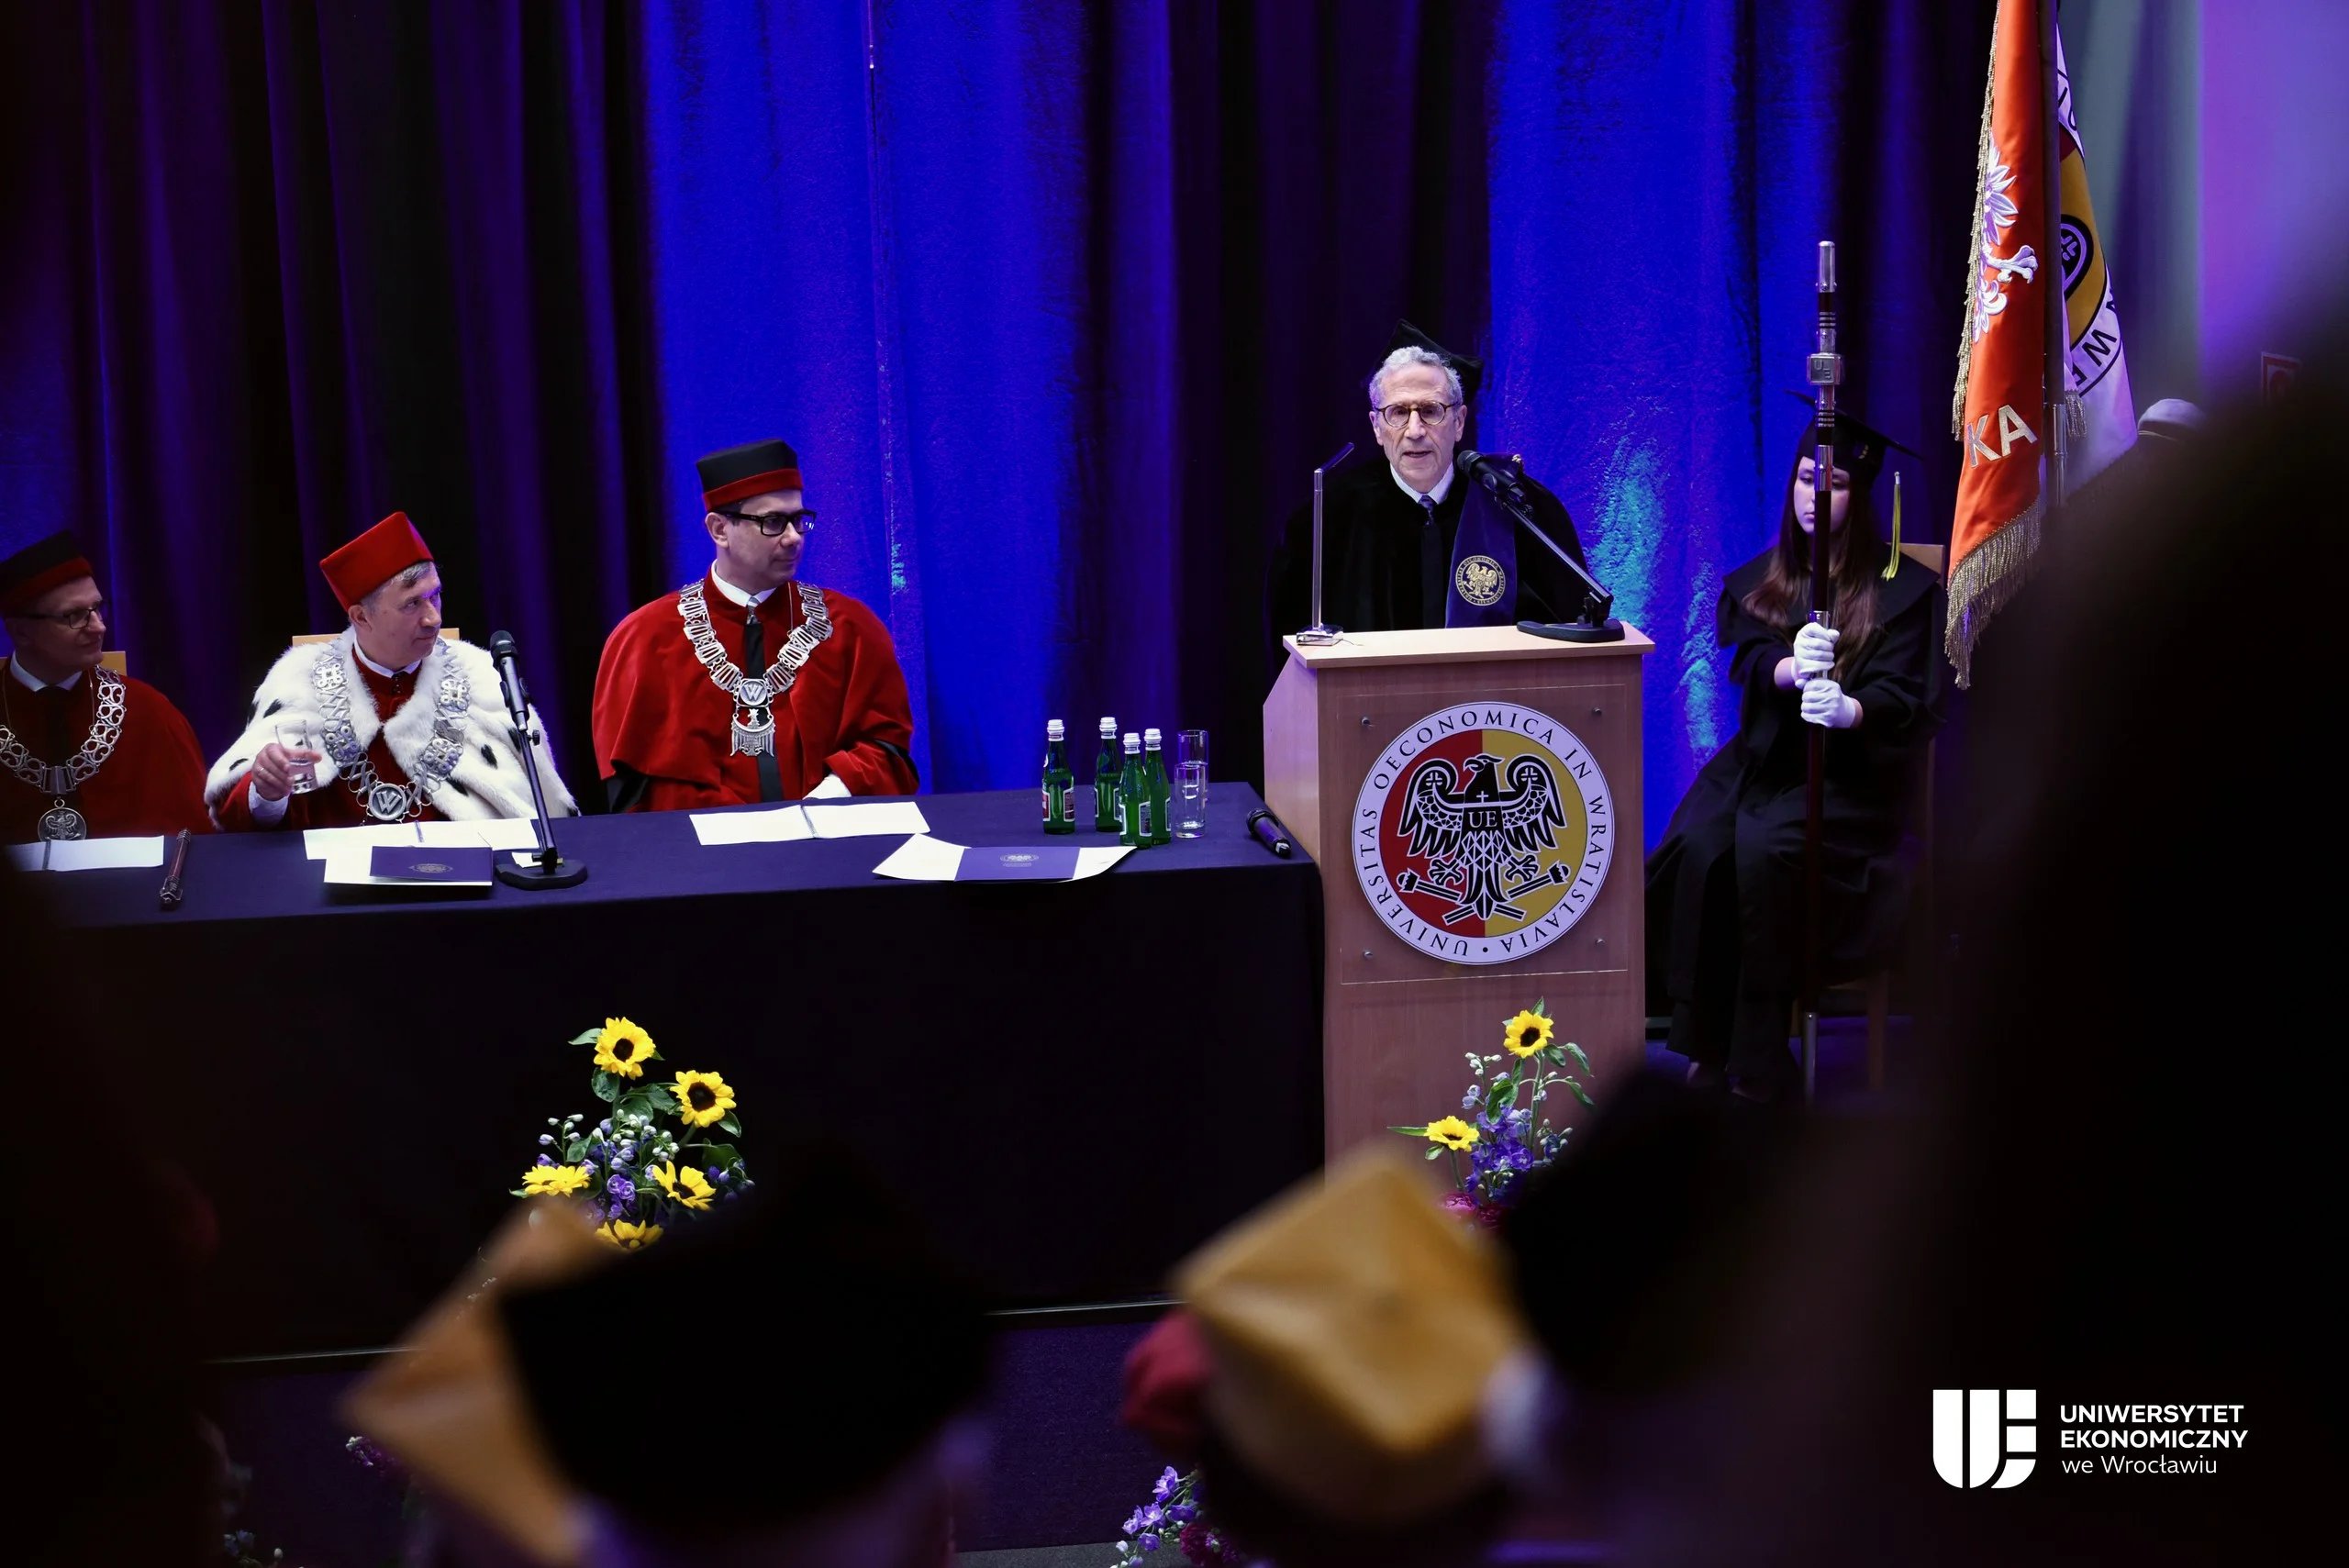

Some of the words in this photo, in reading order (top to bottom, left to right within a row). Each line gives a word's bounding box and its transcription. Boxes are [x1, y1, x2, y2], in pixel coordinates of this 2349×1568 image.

[1374, 709, 1555, 790] OECONOMICA
[1564, 748, 1593, 780] IN
[375, 790, 402, 814] W
[1468, 810, 1497, 828] UE
[1360, 808, 1468, 956] UNIVERSITAS
[1499, 795, 1607, 953] WRATISLAVIA
